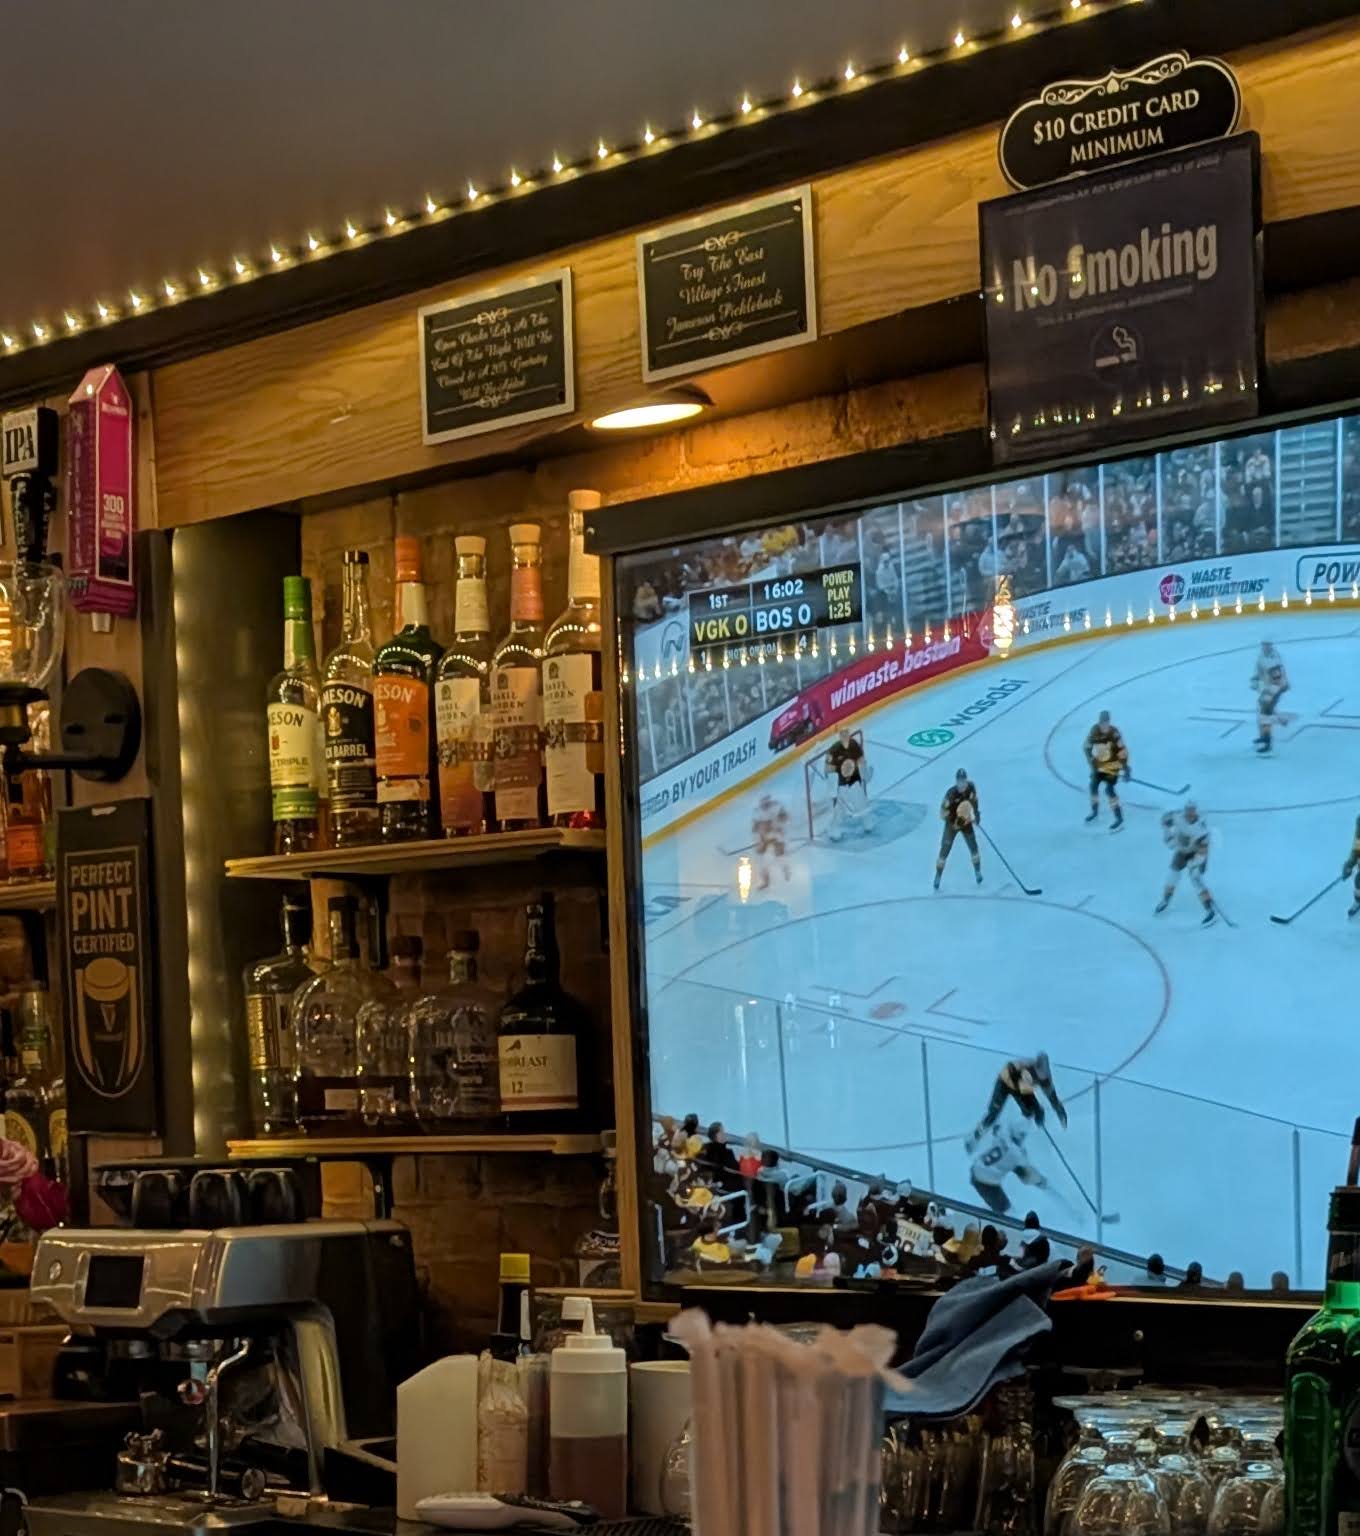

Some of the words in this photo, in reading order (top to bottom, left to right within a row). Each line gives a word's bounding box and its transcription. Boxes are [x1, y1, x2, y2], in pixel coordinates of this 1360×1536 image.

[1033, 116, 1065, 145] $10
[1070, 102, 1141, 135] CREDIT
[1145, 88, 1200, 118] CARD
[1070, 126, 1164, 164] MINIMUM
[708, 254, 733, 273] The
[1012, 256, 1058, 312] No
[1068, 222, 1218, 300] Smoking
[5, 424, 35, 465] IPA
[709, 593, 728, 609] 1ST
[764, 579, 803, 600] 16:02
[827, 586, 851, 602] PLAY
[822, 570, 854, 588] POWER
[1191, 567, 1232, 584] WASTE
[694, 617, 729, 642] VGK
[735, 614, 747, 636] 0
[756, 606, 792, 632] BOS
[798, 603, 811, 625] 0
[829, 602, 851, 619] 1:25
[941, 678, 1031, 728] wasabi
[333, 743, 369, 758] BARREL
[672, 778, 688, 803] BY
[689, 759, 720, 793] YOUR
[722, 737, 757, 774] TRASH
[70, 861, 132, 886] PERFECT
[72, 887, 133, 931] PINT
[73, 932, 136, 954] CERTIFIED
